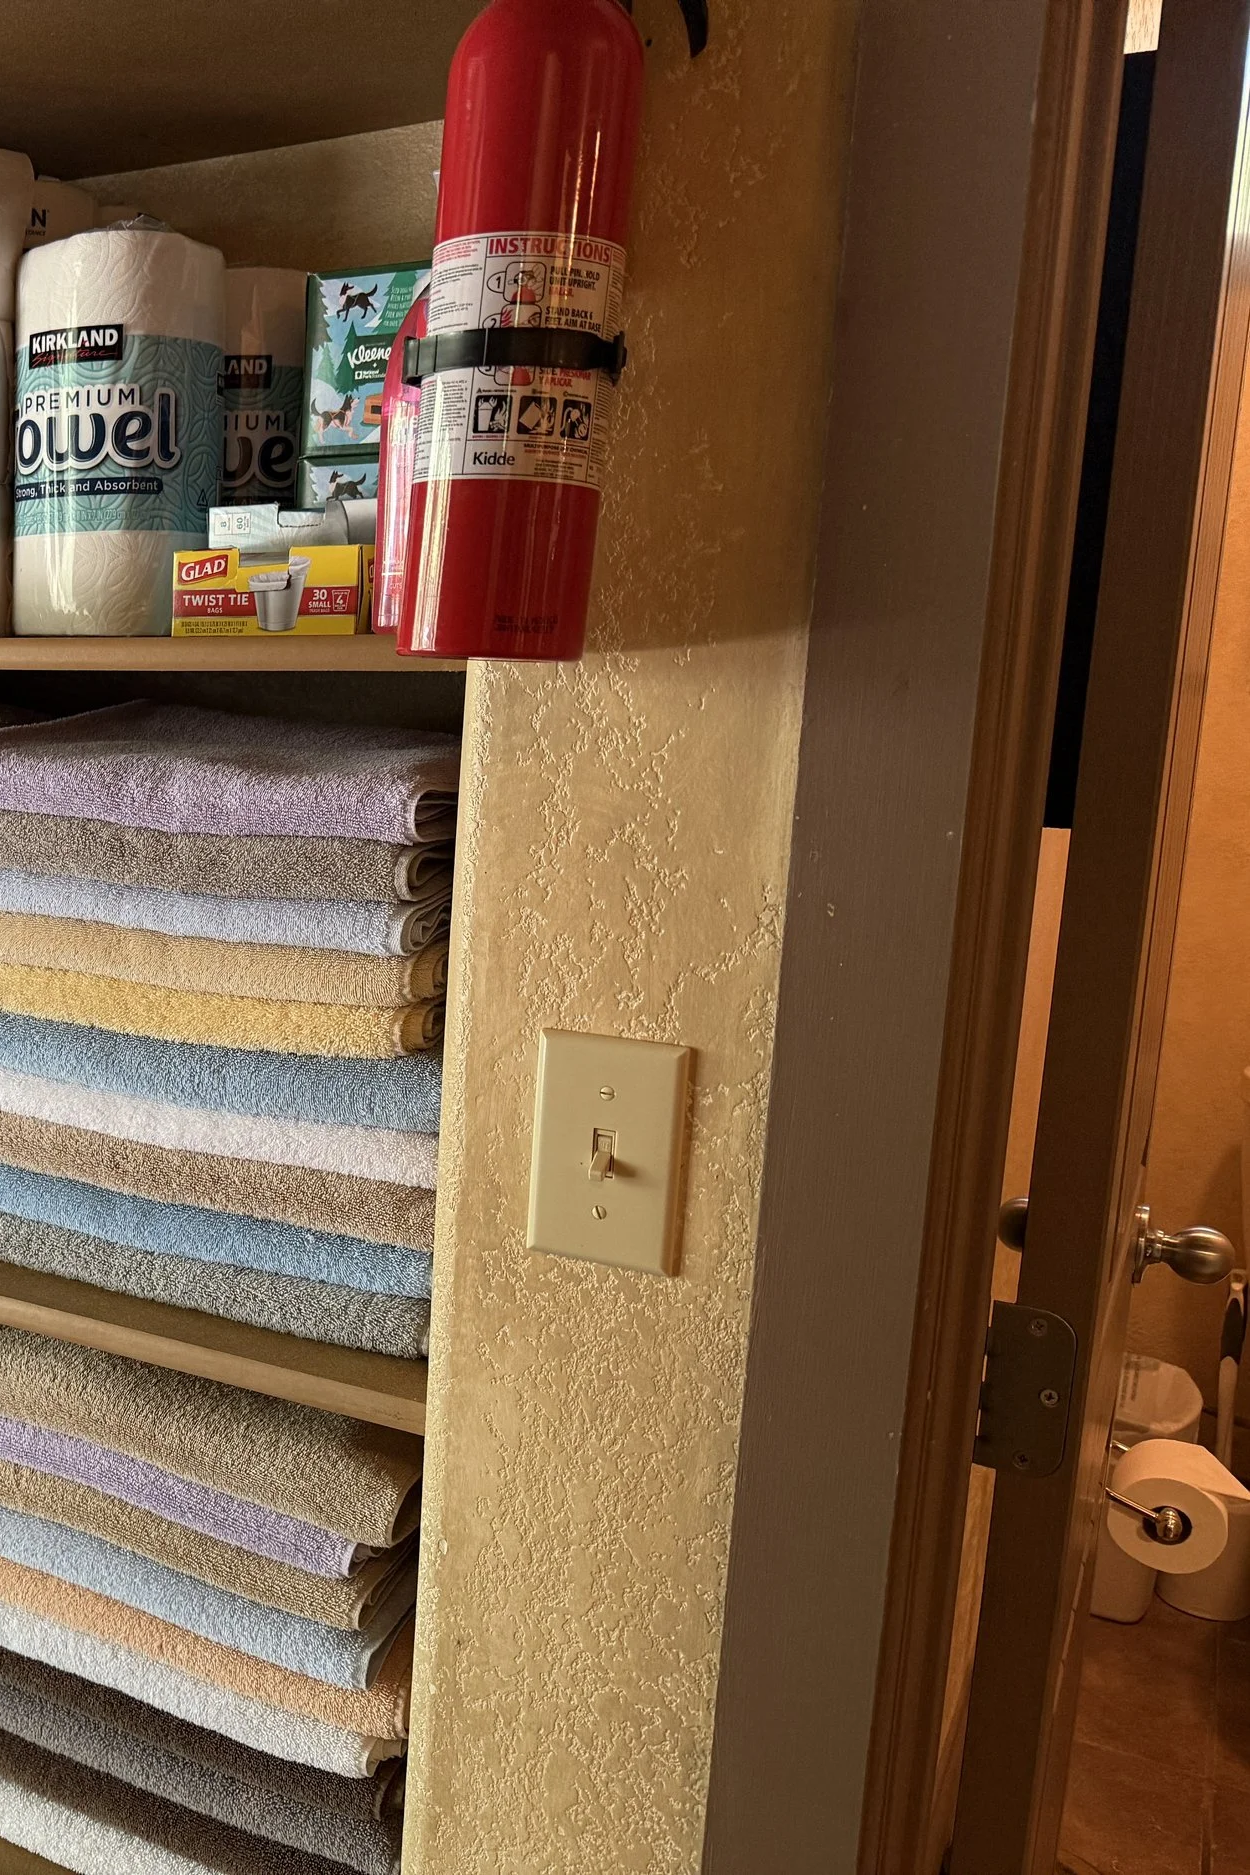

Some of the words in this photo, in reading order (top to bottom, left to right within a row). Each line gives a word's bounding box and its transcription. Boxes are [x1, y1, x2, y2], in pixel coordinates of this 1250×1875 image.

[496, 276, 502, 288] 1
[571, 308, 588, 319] BACK
[564, 318, 578, 328] AIM
[578, 320, 588, 329] AT
[32, 328, 119, 355] KIRKLAND
[347, 344, 392, 369] Kleene
[25, 388, 135, 414] PREMIUM
[14, 393, 176, 467] owel
[472, 451, 516, 466] Kidde
[16, 486, 38, 498] Strong,
[69, 480, 90, 492] and
[94, 480, 158, 492] Absorbent
[182, 559, 226, 581] GLAD
[182, 594, 225, 606] TWIST
[228, 594, 249, 606] TIE
[312, 589, 328, 600] 30
